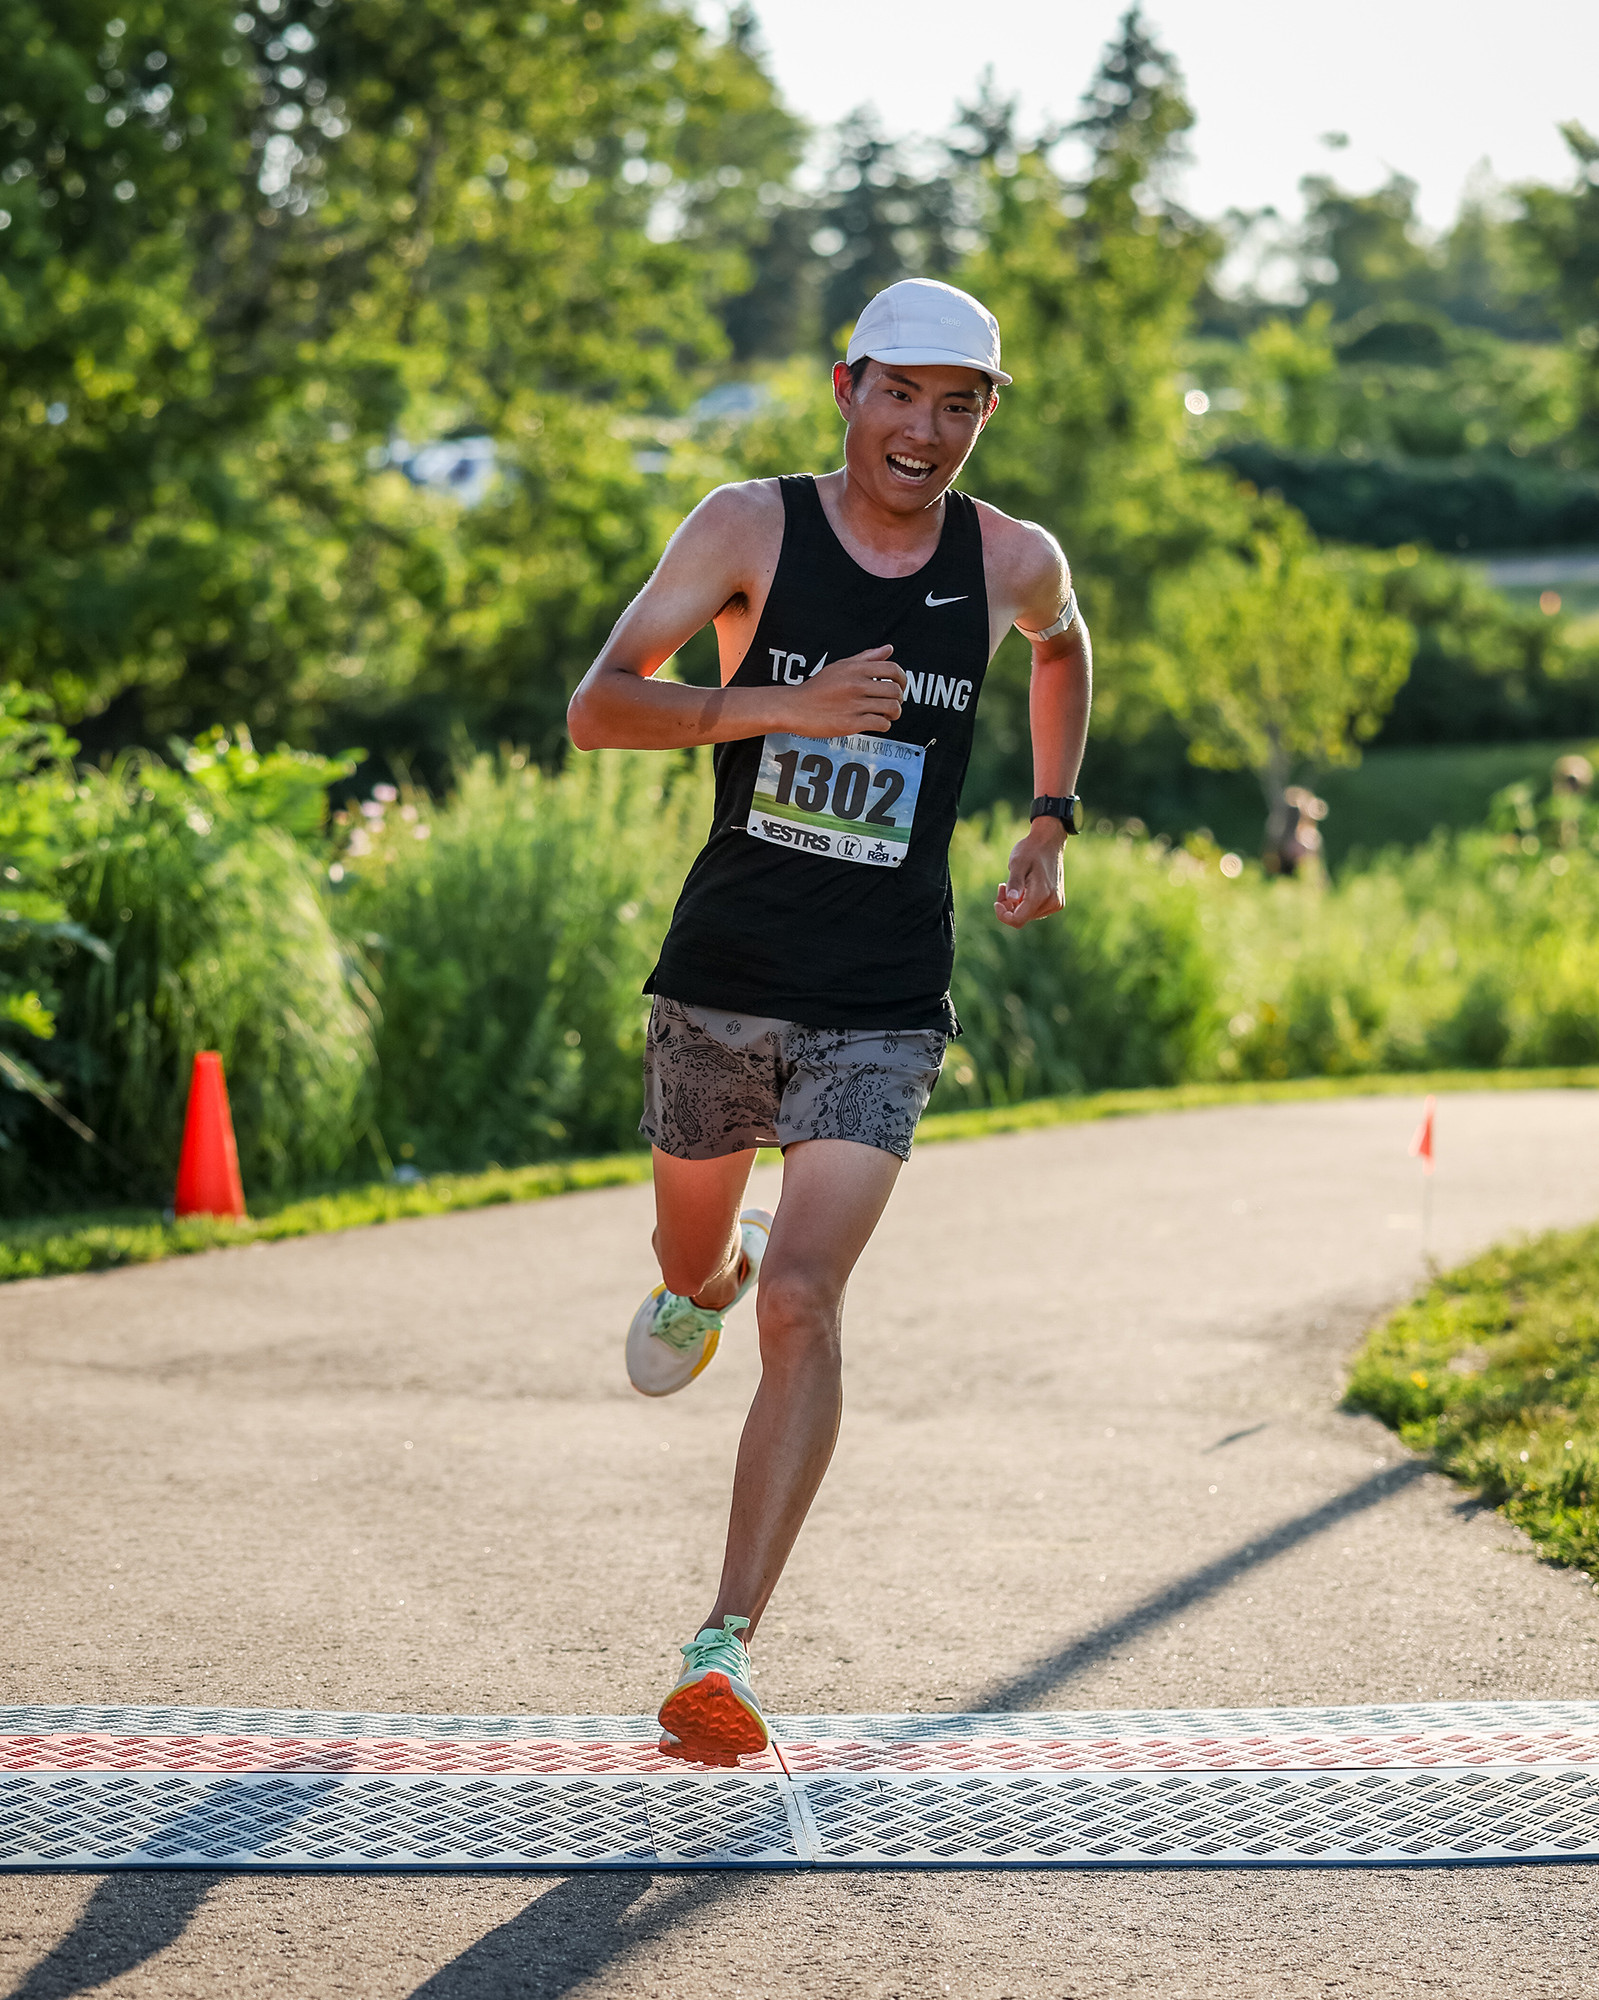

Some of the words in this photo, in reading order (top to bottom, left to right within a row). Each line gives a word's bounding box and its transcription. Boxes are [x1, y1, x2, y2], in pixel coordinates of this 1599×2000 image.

[768, 647, 807, 686] TC
[873, 670, 973, 712] NING
[836, 736, 855, 751] TRAIL
[857, 738, 872, 753] RUN
[873, 742, 893, 758] SERIES
[895, 746, 913, 761] 2025
[774, 749, 905, 828] 1302
